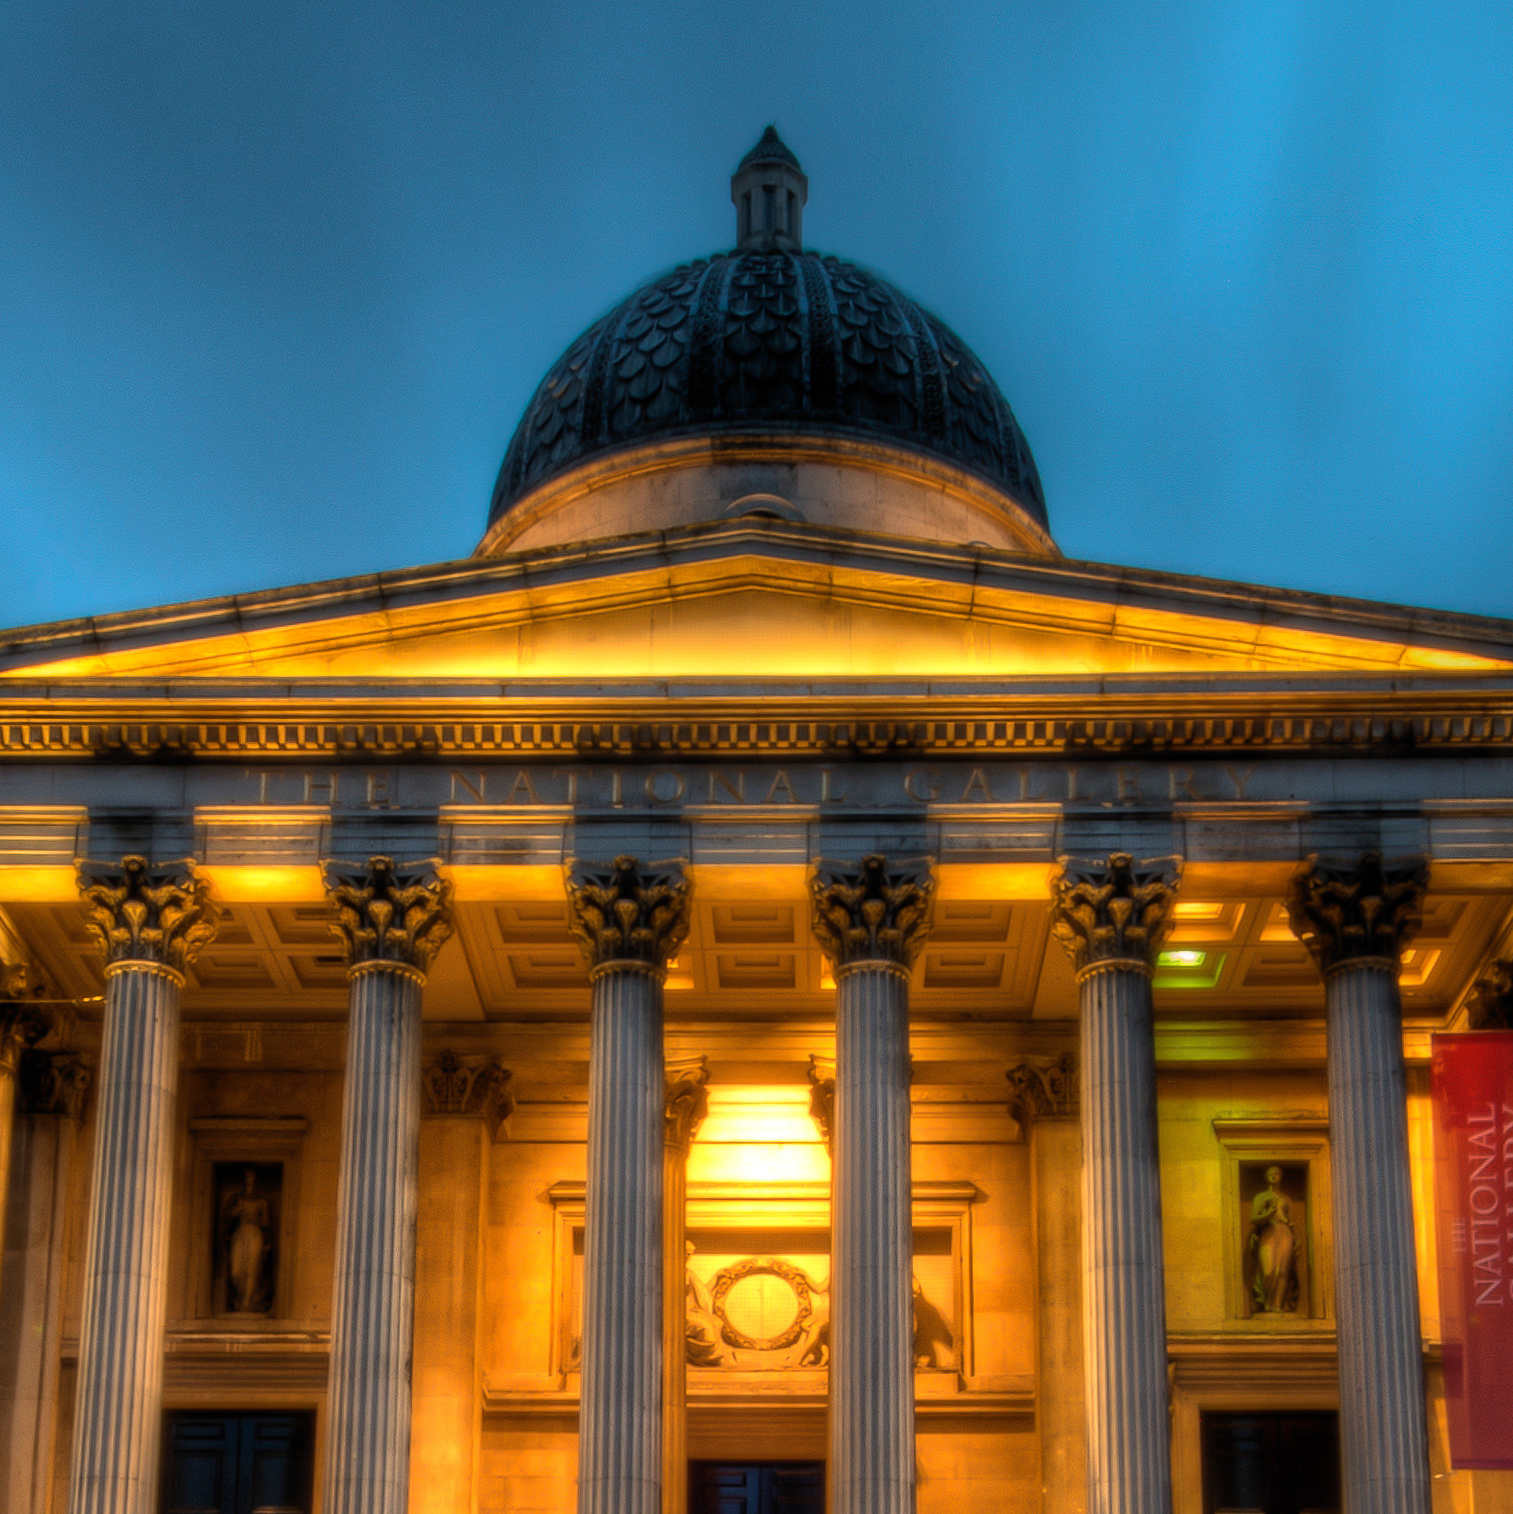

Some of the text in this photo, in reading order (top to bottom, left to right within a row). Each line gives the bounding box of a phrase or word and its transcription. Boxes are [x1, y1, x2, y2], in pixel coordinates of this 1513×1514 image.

[245, 764, 1258, 805] THE NATIONAL GALLERY
[1466, 1102, 1504, 1308] NATIONAL
